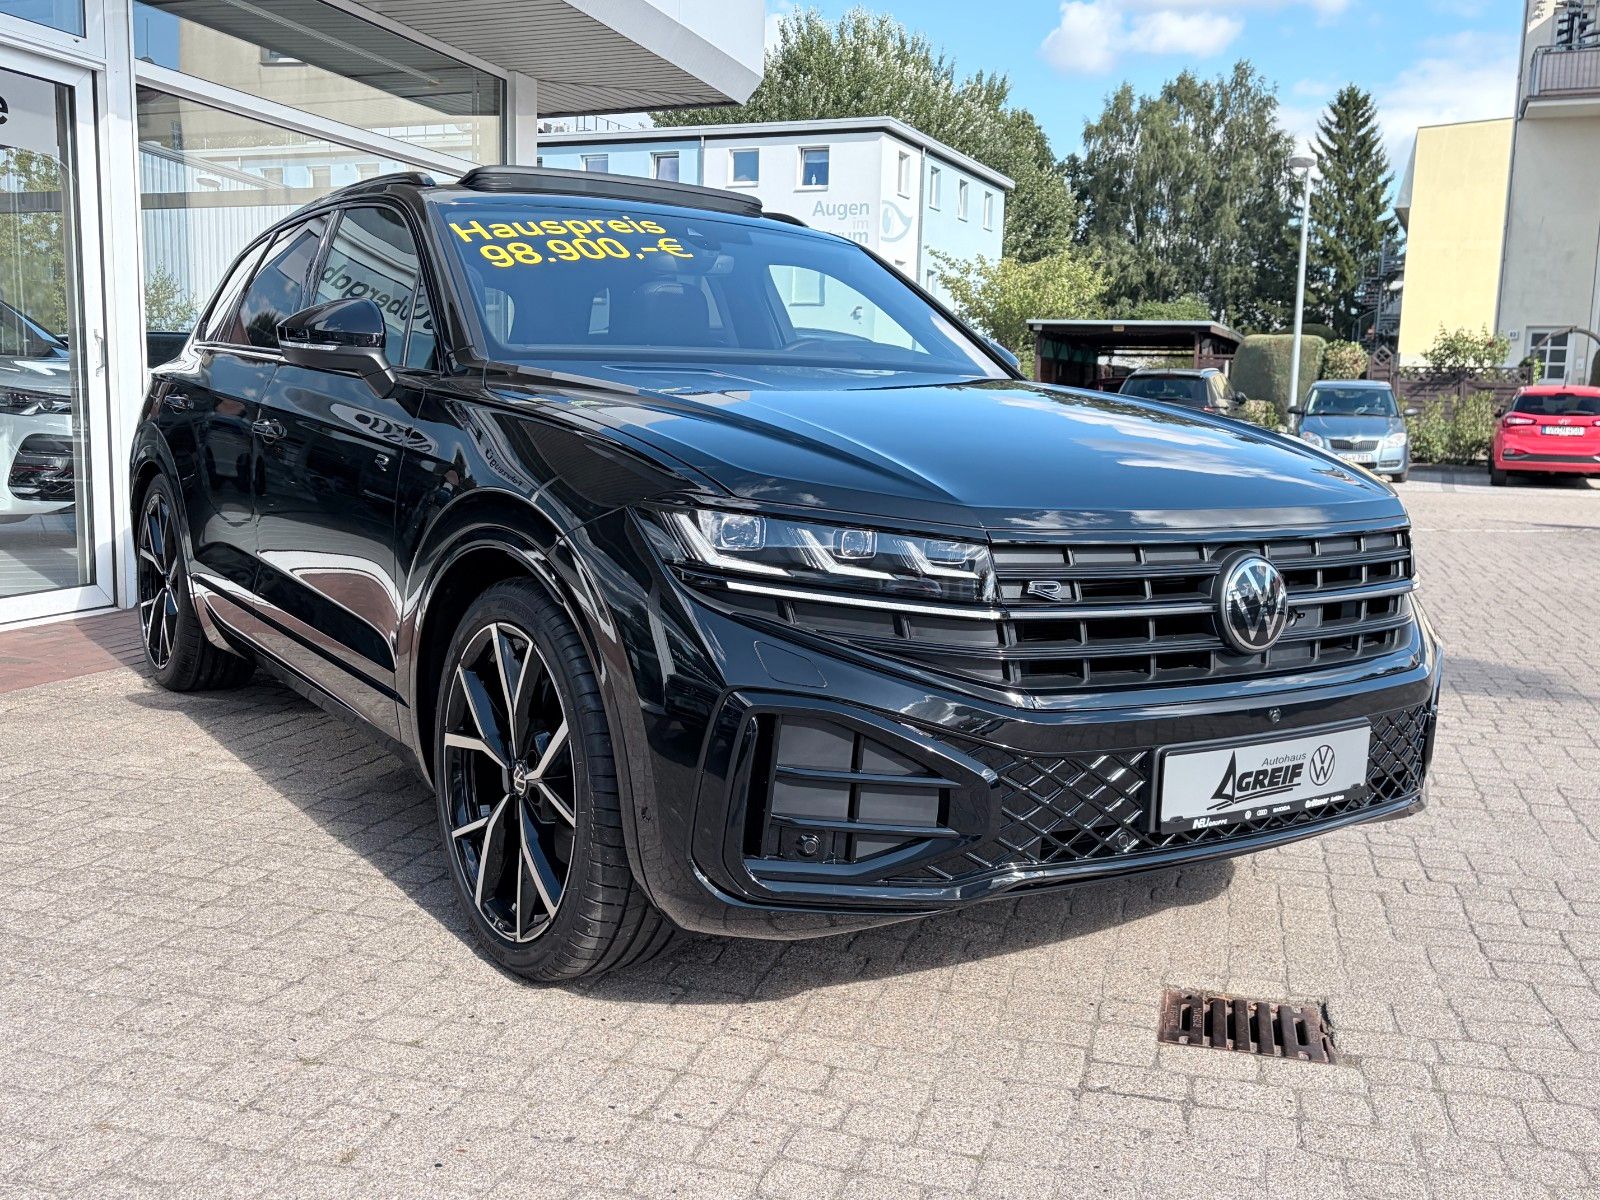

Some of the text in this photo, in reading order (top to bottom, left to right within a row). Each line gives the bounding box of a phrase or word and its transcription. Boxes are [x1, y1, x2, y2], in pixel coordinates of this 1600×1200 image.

[812, 200, 870, 221] Augen
[449, 216, 667, 243] Hauspreis
[852, 217, 869, 230] im
[1261, 753, 1307, 767] Autohaus
[1236, 763, 1304, 792] GREIF
